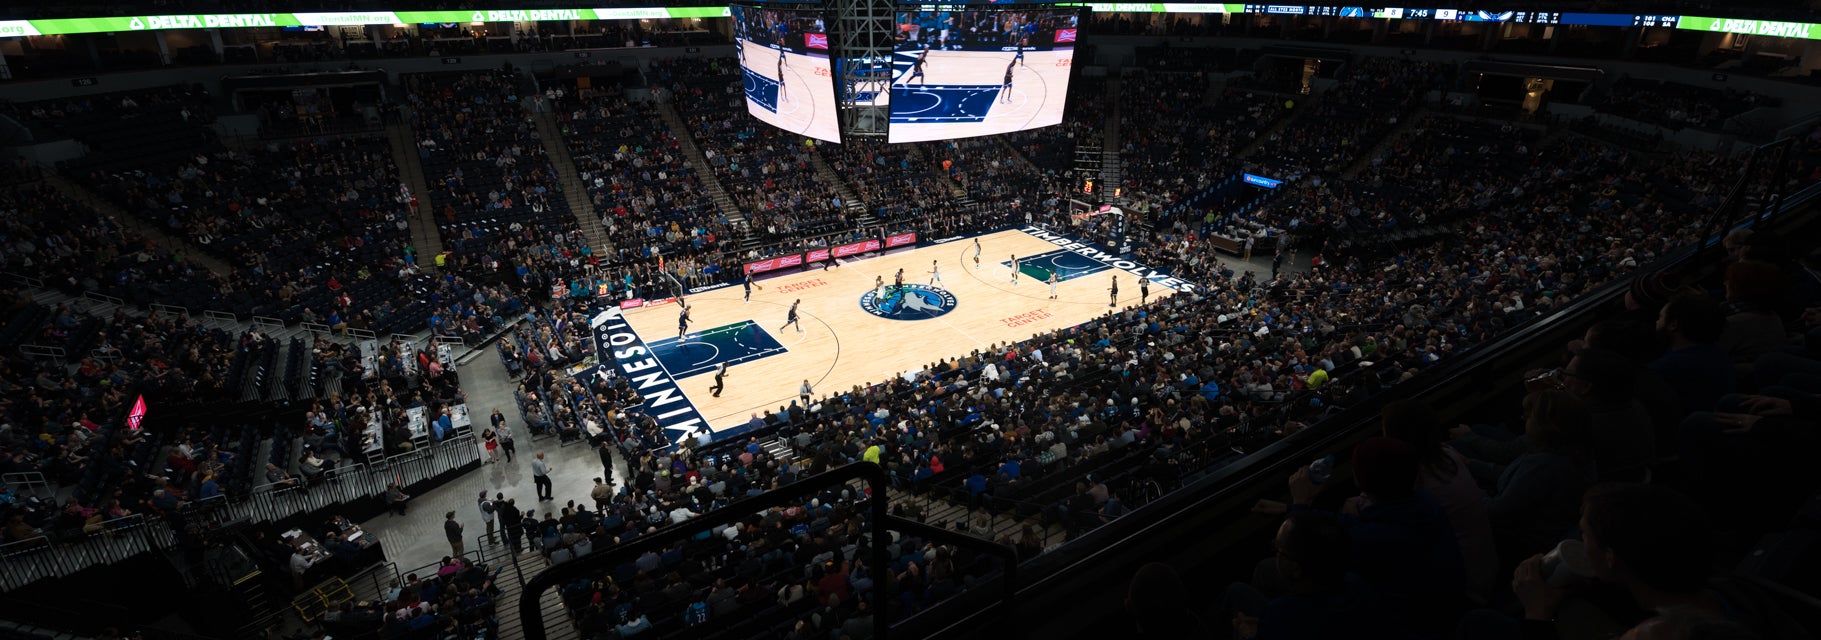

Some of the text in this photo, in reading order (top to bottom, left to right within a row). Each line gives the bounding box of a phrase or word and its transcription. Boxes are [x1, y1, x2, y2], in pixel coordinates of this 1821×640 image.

[487, 10, 580, 21] DELTA DENTAL
[1410, 9, 1428, 17] 7:45
[148, 14, 275, 29] DELTA DENTAL
[1721, 19, 1811, 38] DELTA DENTAL
[1021, 226, 1196, 293] TIMBERWOLVES
[776, 278, 822, 290] TARGET
[779, 281, 827, 294] CENTER
[999, 308, 1045, 323] TARGET
[1007, 312, 1053, 328] CENTER
